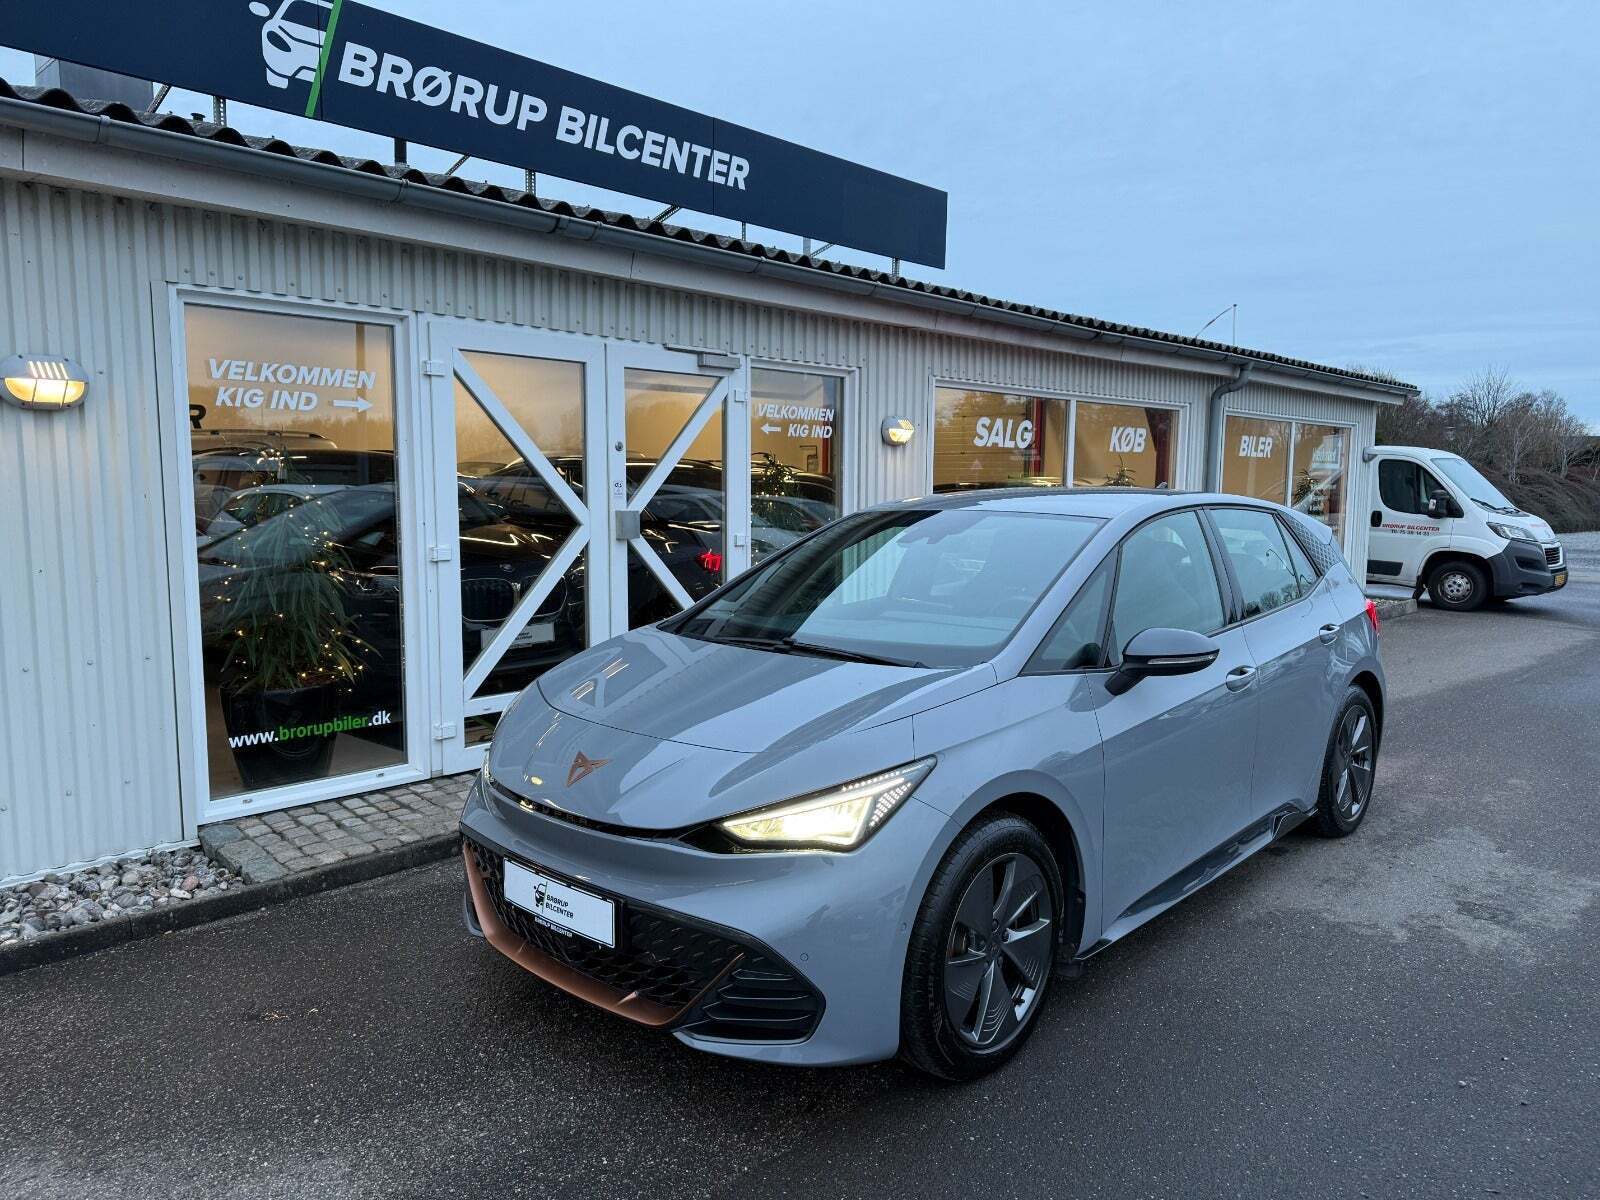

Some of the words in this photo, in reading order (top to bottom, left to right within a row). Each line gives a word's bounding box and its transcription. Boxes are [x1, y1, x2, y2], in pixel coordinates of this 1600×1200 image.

[338, 41, 548, 131] BRØRUP
[555, 105, 750, 190] BILCENTER
[208, 357, 376, 389] VELKOMMEN
[215, 387, 265, 409] KIG
[270, 390, 318, 411] IND
[758, 403, 834, 421] VELKOMMEN
[788, 423, 809, 438] KIG
[811, 425, 833, 439] IND
[973, 416, 1034, 449] SALG
[1109, 426, 1147, 453] KØB
[1239, 435, 1273, 458] BILER
[228, 710, 391, 749] www.brorupbiler.dk
[545, 902, 574, 920] BILCENTER
